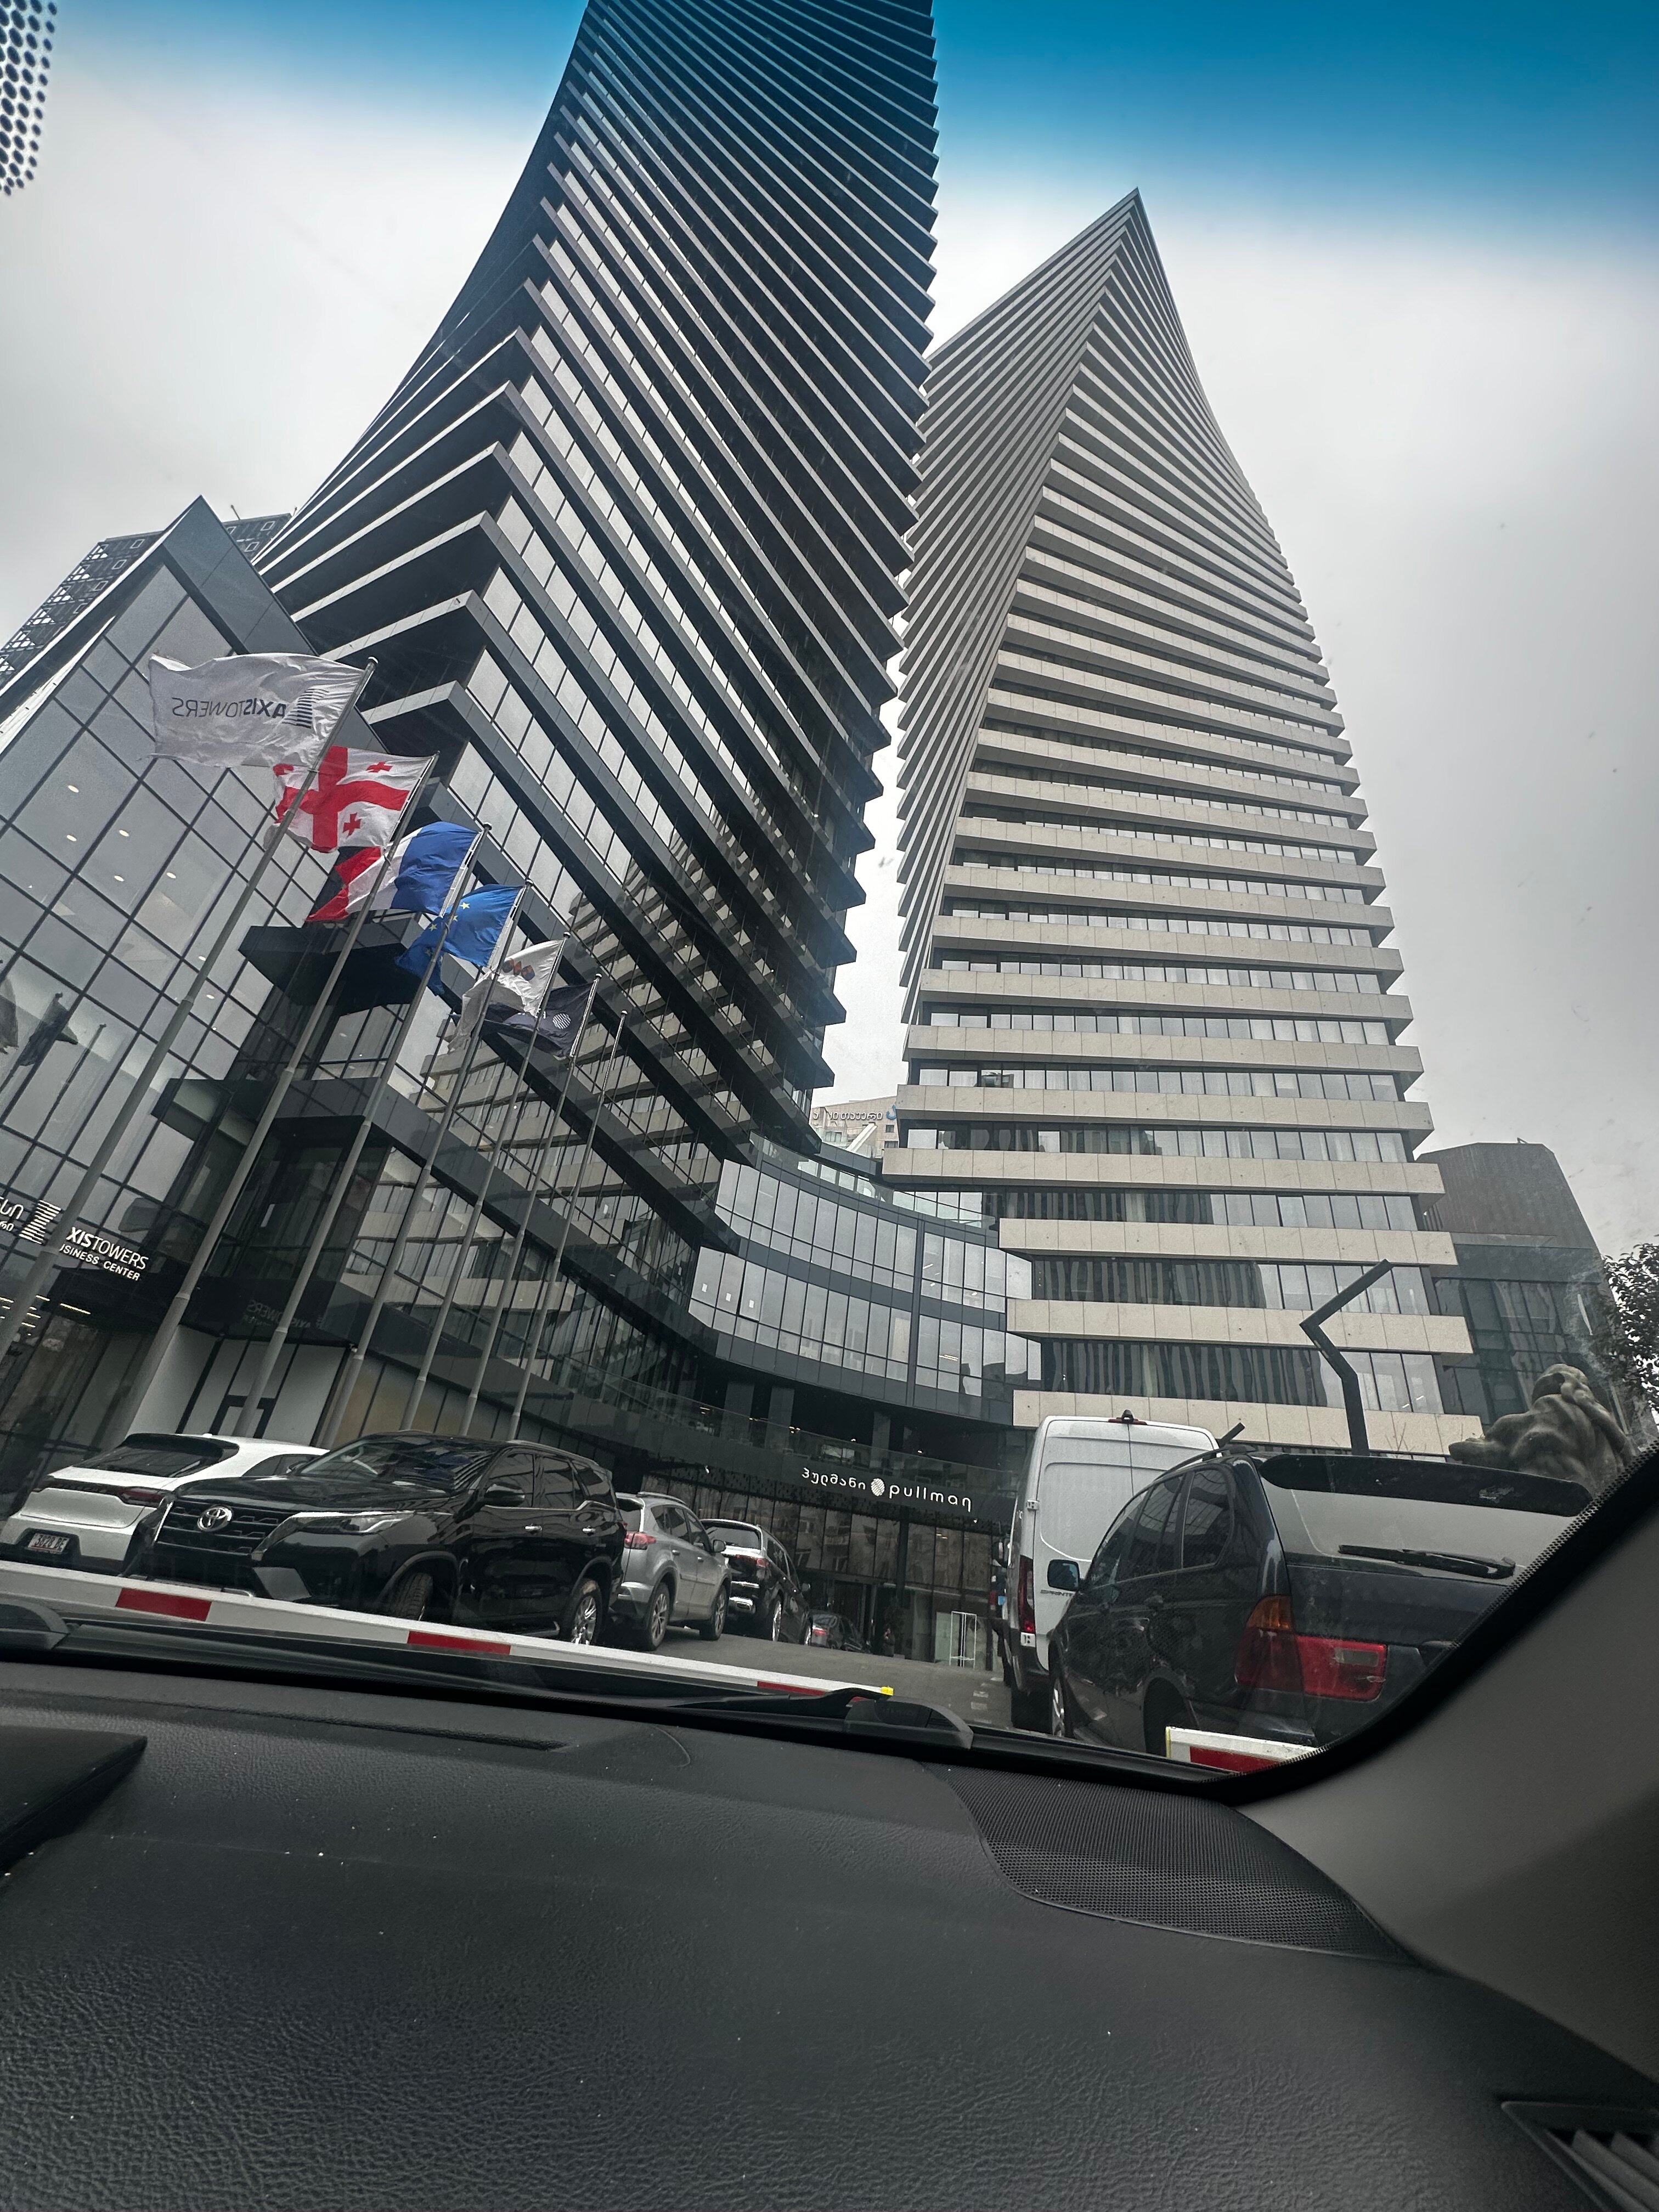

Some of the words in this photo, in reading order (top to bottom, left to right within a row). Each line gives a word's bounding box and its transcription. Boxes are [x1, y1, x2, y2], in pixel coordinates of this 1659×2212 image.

[66, 1227, 149, 1270] XISTOWERS
[103, 1261, 140, 1281] CENTER
[889, 1483, 972, 1513] pullman
